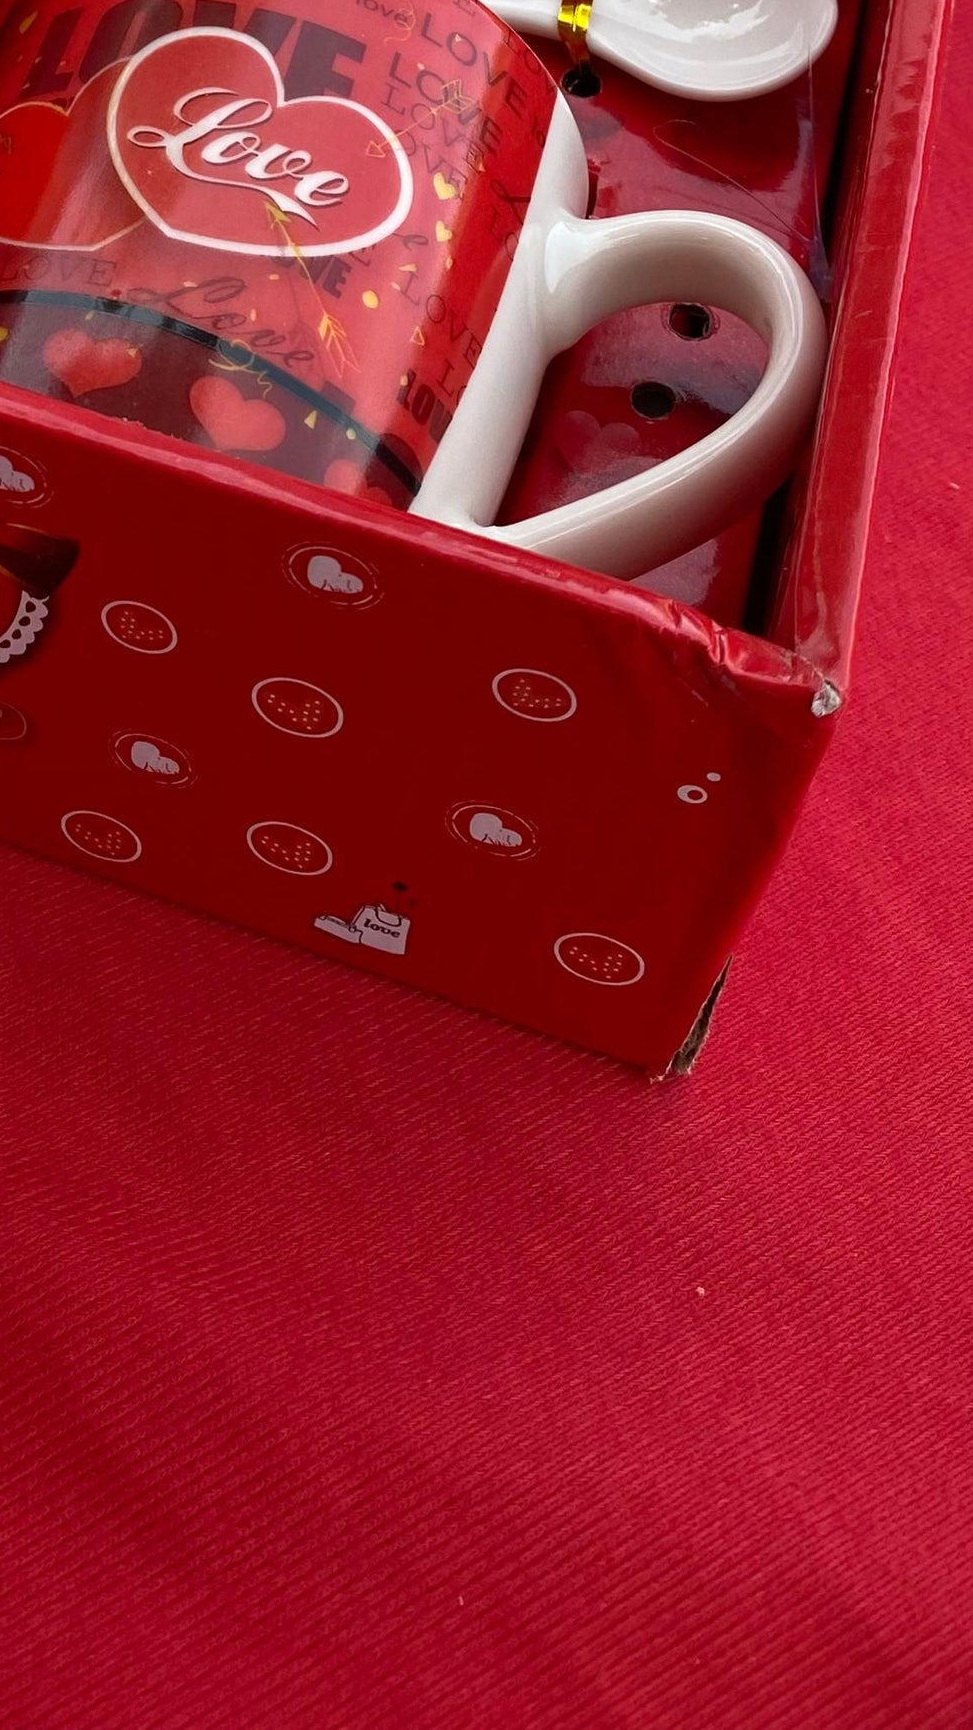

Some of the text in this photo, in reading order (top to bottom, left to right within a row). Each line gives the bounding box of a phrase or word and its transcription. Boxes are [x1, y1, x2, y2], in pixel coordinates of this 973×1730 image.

[420, 13, 527, 117] LOVE
[127, 87, 350, 227] Love
[125, 276, 315, 368] Love
[362, 916, 401, 939] love
